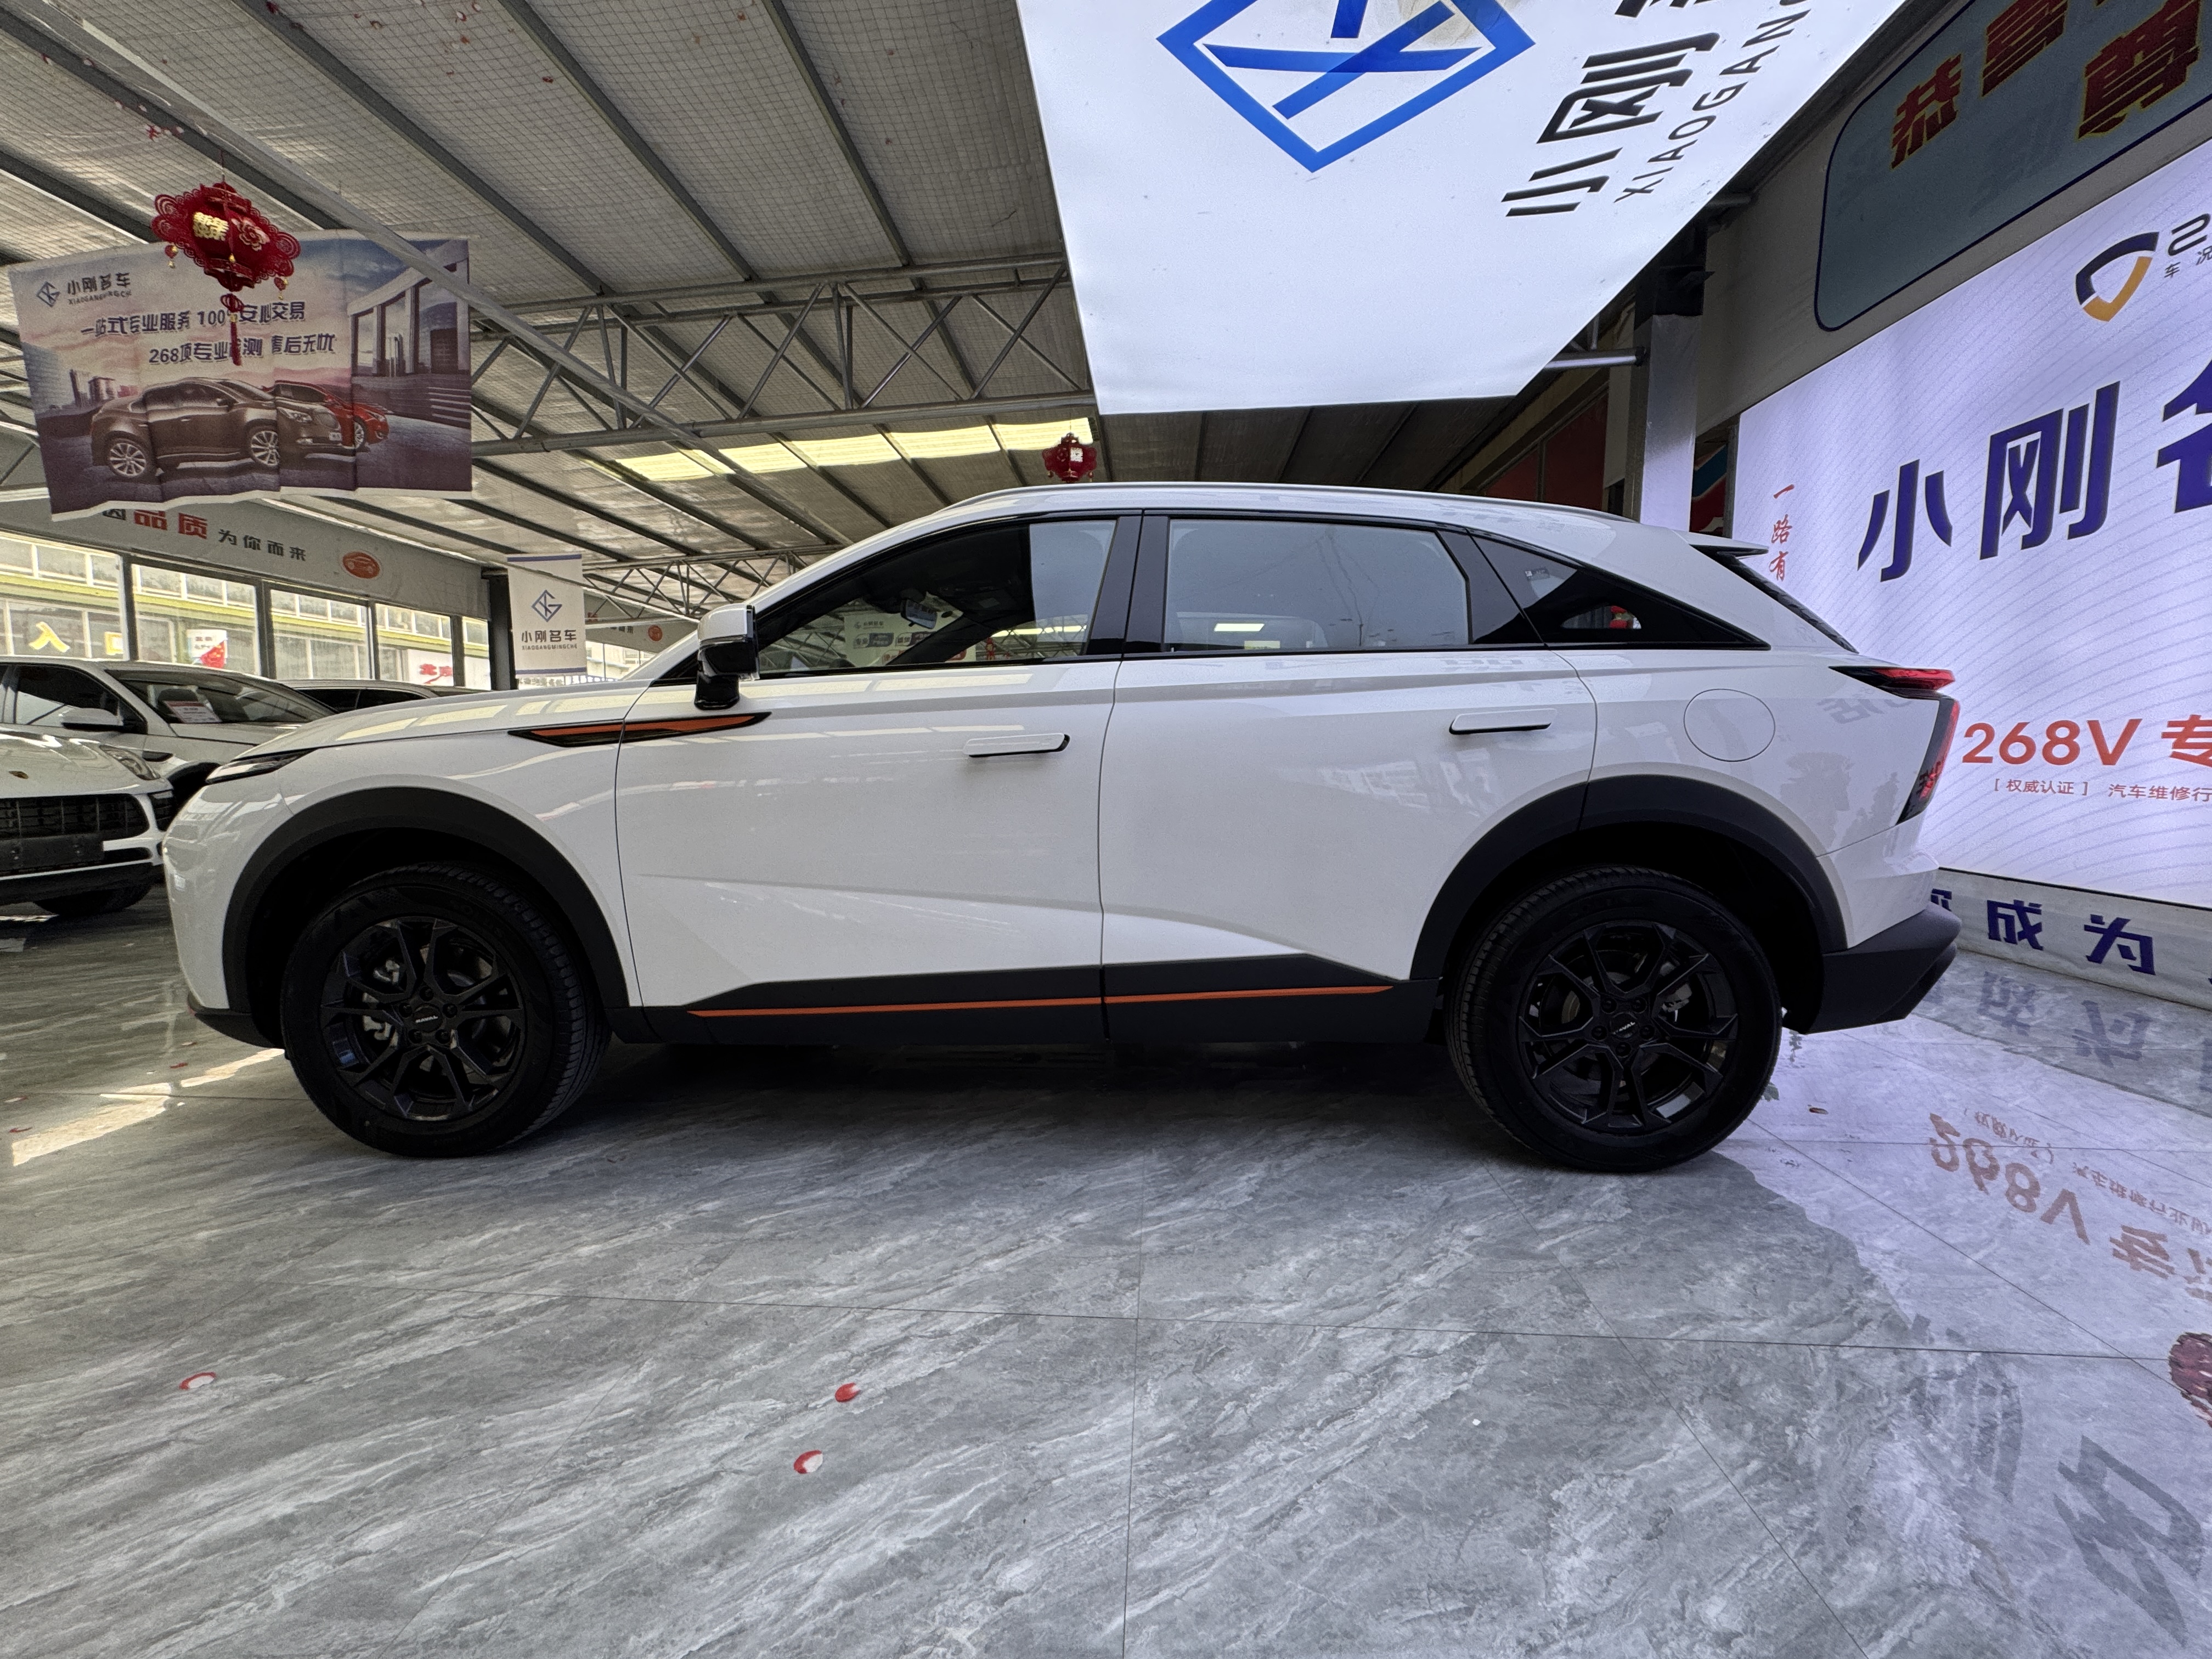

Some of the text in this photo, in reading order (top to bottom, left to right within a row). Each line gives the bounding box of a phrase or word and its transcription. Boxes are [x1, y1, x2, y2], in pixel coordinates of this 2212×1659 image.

[1502, 0, 1719, 217] 小刚
[1614, 0, 1812, 203] XIAOGAN
[1891, 0, 2112, 168] 恭喜
[67, 272, 131, 295] 小刚名车
[197, 302, 305, 326] 100安心交易
[521, 629, 578, 643] 小刚名车
[1961, 718, 2143, 766] 268V
[1931, 888, 2156, 975] 成为
